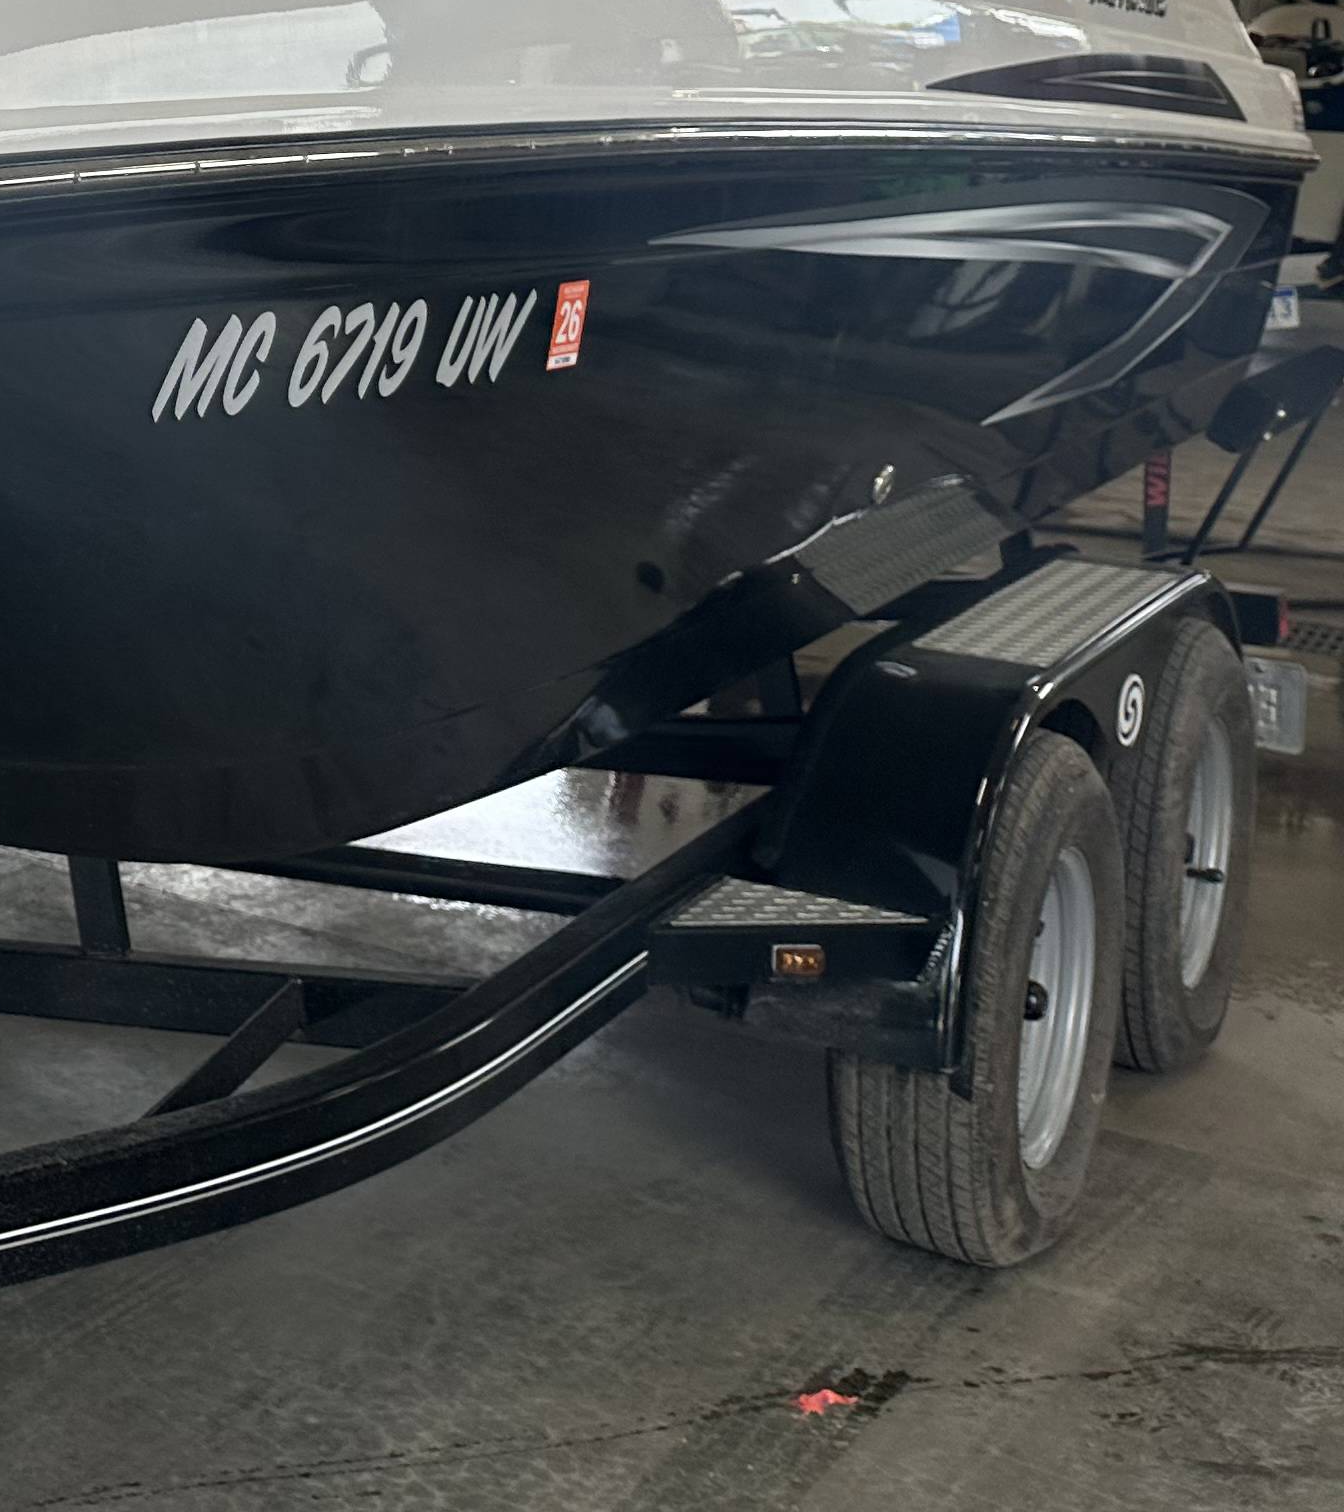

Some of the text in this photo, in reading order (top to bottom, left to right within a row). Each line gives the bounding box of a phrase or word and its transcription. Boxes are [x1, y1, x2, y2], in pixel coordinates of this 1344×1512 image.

[152, 287, 538, 423] MC 6719 UW
[554, 298, 583, 345] 26
